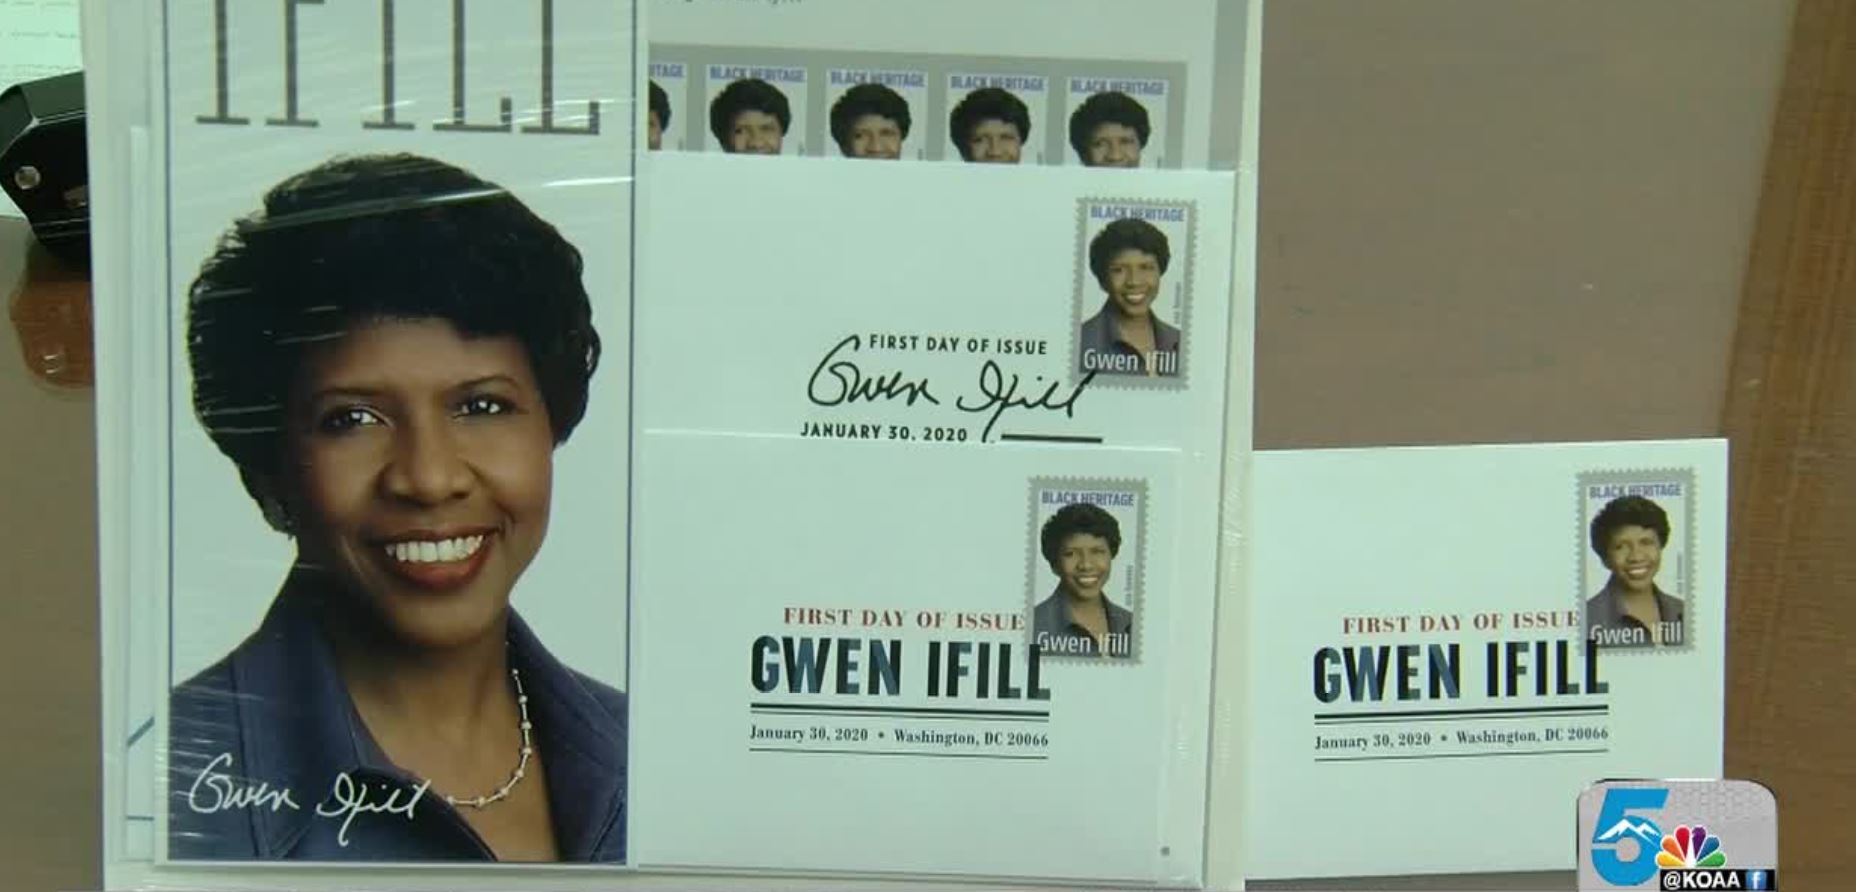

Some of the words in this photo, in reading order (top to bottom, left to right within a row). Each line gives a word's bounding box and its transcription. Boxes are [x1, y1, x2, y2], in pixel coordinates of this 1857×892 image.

[710, 66, 747, 80] BLACK
[750, 67, 805, 83] HERITAGE
[831, 71, 866, 85] BLACK
[869, 72, 925, 87] HERITAGE
[951, 76, 986, 89] BLACK
[990, 77, 1044, 91] HERITAGE
[1071, 80, 1106, 93] BLACK
[1110, 81, 1165, 95] HERITAGE
[1091, 206, 1127, 219] BLACK
[1130, 207, 1184, 222] HERITAGE
[869, 334, 919, 350] FIRST
[926, 336, 961, 352] DAY
[967, 338, 990, 353] OF
[996, 340, 1047, 355] ISSUE
[808, 334, 940, 407] Gwen
[1084, 348, 1138, 371] Gwen
[1145, 350, 1177, 374] Ifill
[800, 422, 882, 439] JANUARY
[924, 427, 967, 442] 2020
[1041, 491, 1077, 504] BLACK
[1081, 492, 1134, 506] HERITAGE
[1589, 486, 1625, 499] BLACK
[1628, 484, 1681, 497] HERITAGE
[784, 607, 852, 625] FIRST
[861, 609, 905, 627] DAY
[917, 611, 948, 629] OF
[956, 612, 1025, 631] ISSUE
[1343, 616, 1410, 634] FIRST
[1420, 615, 1461, 632] DAY
[1473, 613, 1502, 630] OF
[1513, 611, 1579, 628] ISSUE
[1037, 631, 1091, 654] Gwen
[1098, 632, 1129, 655] Ifill
[1590, 624, 1645, 645] Gwen
[1651, 621, 1682, 645] Ifill
[751, 635, 902, 696] GWEN
[927, 641, 1051, 700] IFILL
[1313, 644, 1460, 703] GWEN
[1486, 639, 1609, 697] IFILL
[749, 726, 804, 743] January
[809, 727, 831, 742] 30,
[835, 728, 868, 742] 2020
[894, 729, 979, 747] Washington,
[984, 732, 1003, 745] DC
[1007, 732, 1048, 747] 20066
[1314, 735, 1368, 751] January
[1373, 735, 1394, 748] 30,
[1398, 732, 1431, 746] 2020
[1456, 729, 1541, 745] Washington,
[1544, 728, 1563, 741] DC
[1567, 727, 1608, 741] 20066
[188, 752, 300, 814] Gwen
